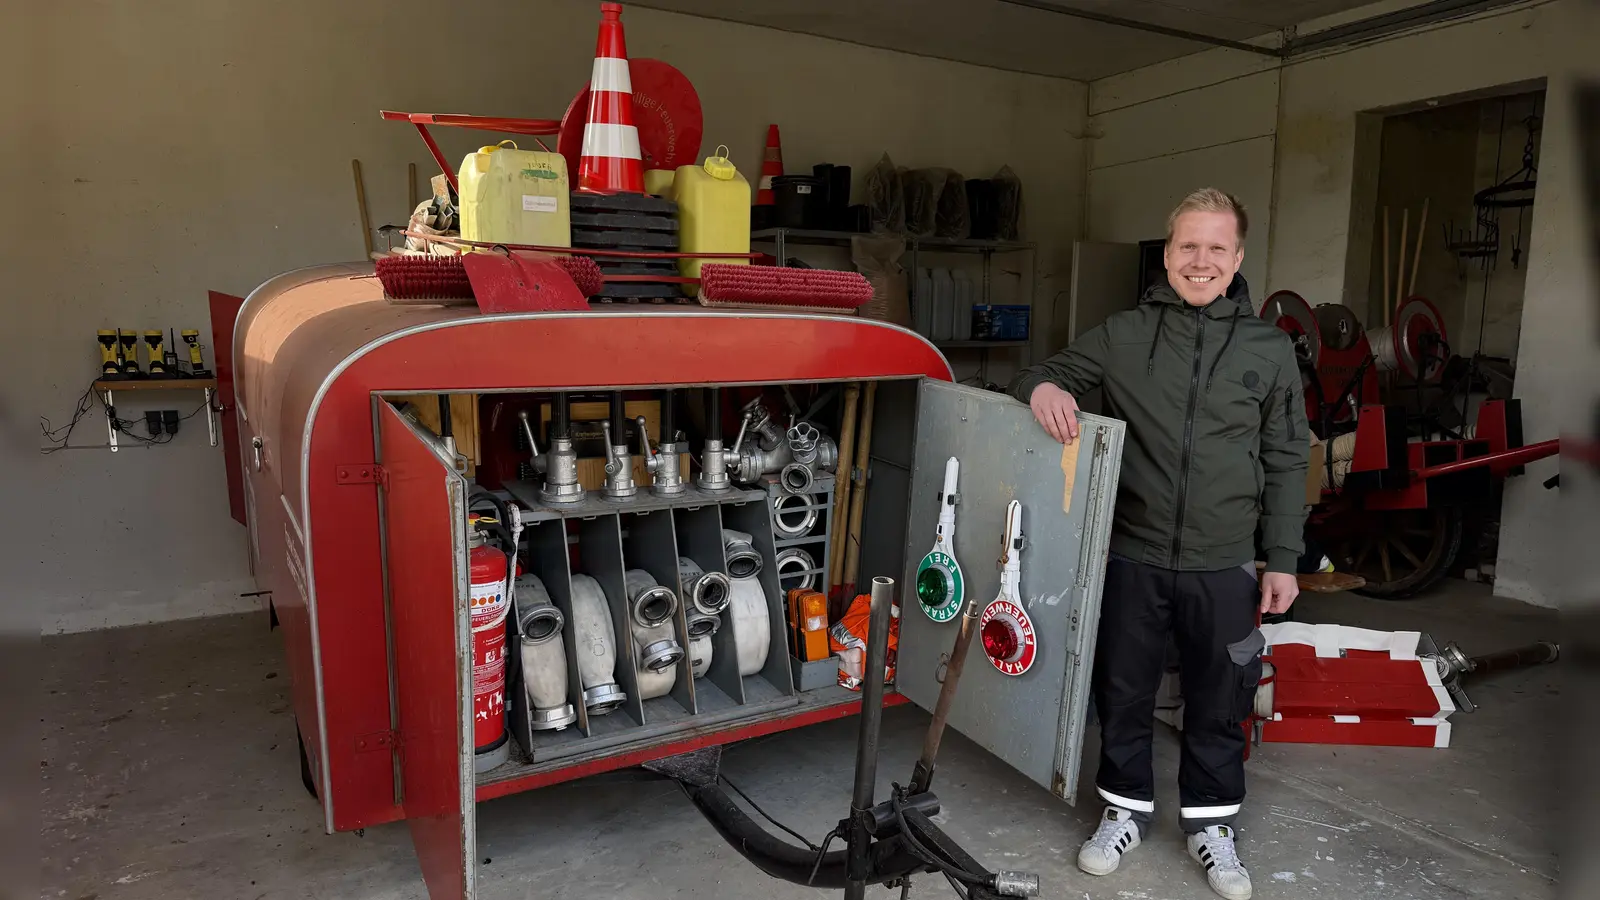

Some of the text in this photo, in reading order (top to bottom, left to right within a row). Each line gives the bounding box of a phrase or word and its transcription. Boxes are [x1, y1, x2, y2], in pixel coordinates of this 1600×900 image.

[632, 91, 676, 163] illige Feuerwehr
[928, 553, 957, 574] FREI
